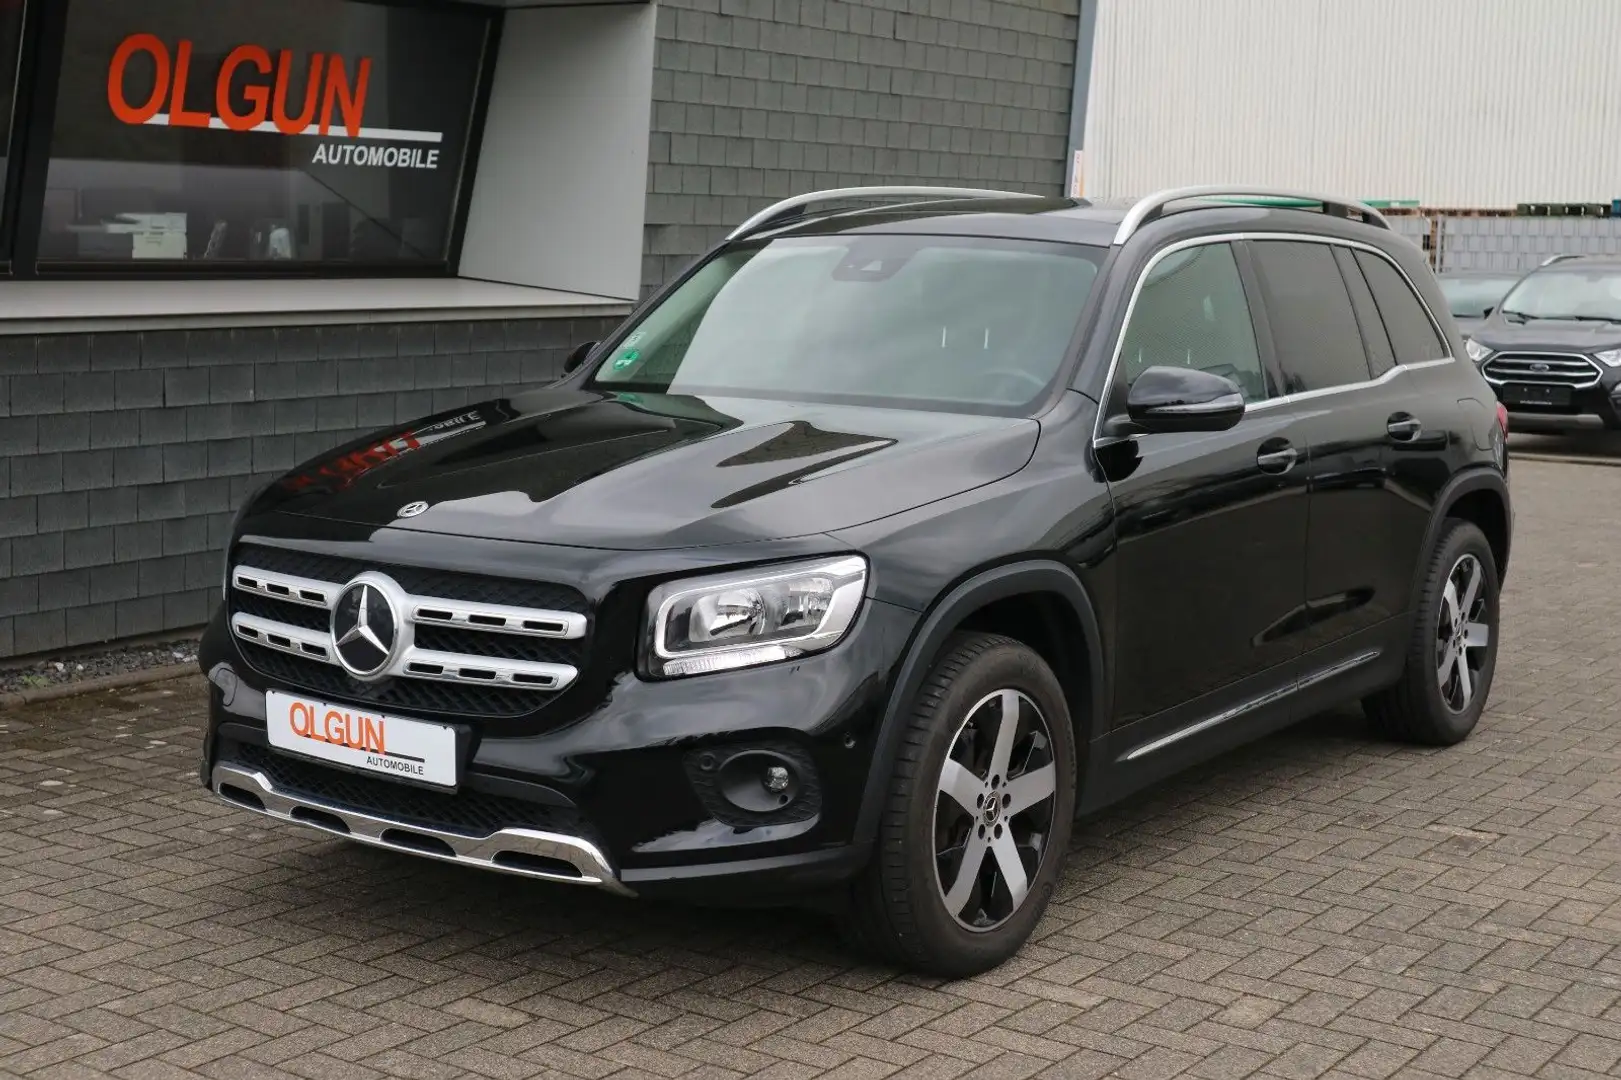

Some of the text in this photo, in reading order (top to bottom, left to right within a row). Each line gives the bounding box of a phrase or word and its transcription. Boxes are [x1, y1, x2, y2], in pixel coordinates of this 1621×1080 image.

[108, 33, 371, 137] OLGUN
[312, 144, 439, 168] AUTOMOBILE
[290, 702, 385, 754] OLGUN
[366, 756, 424, 775] AUTOMOBILE
